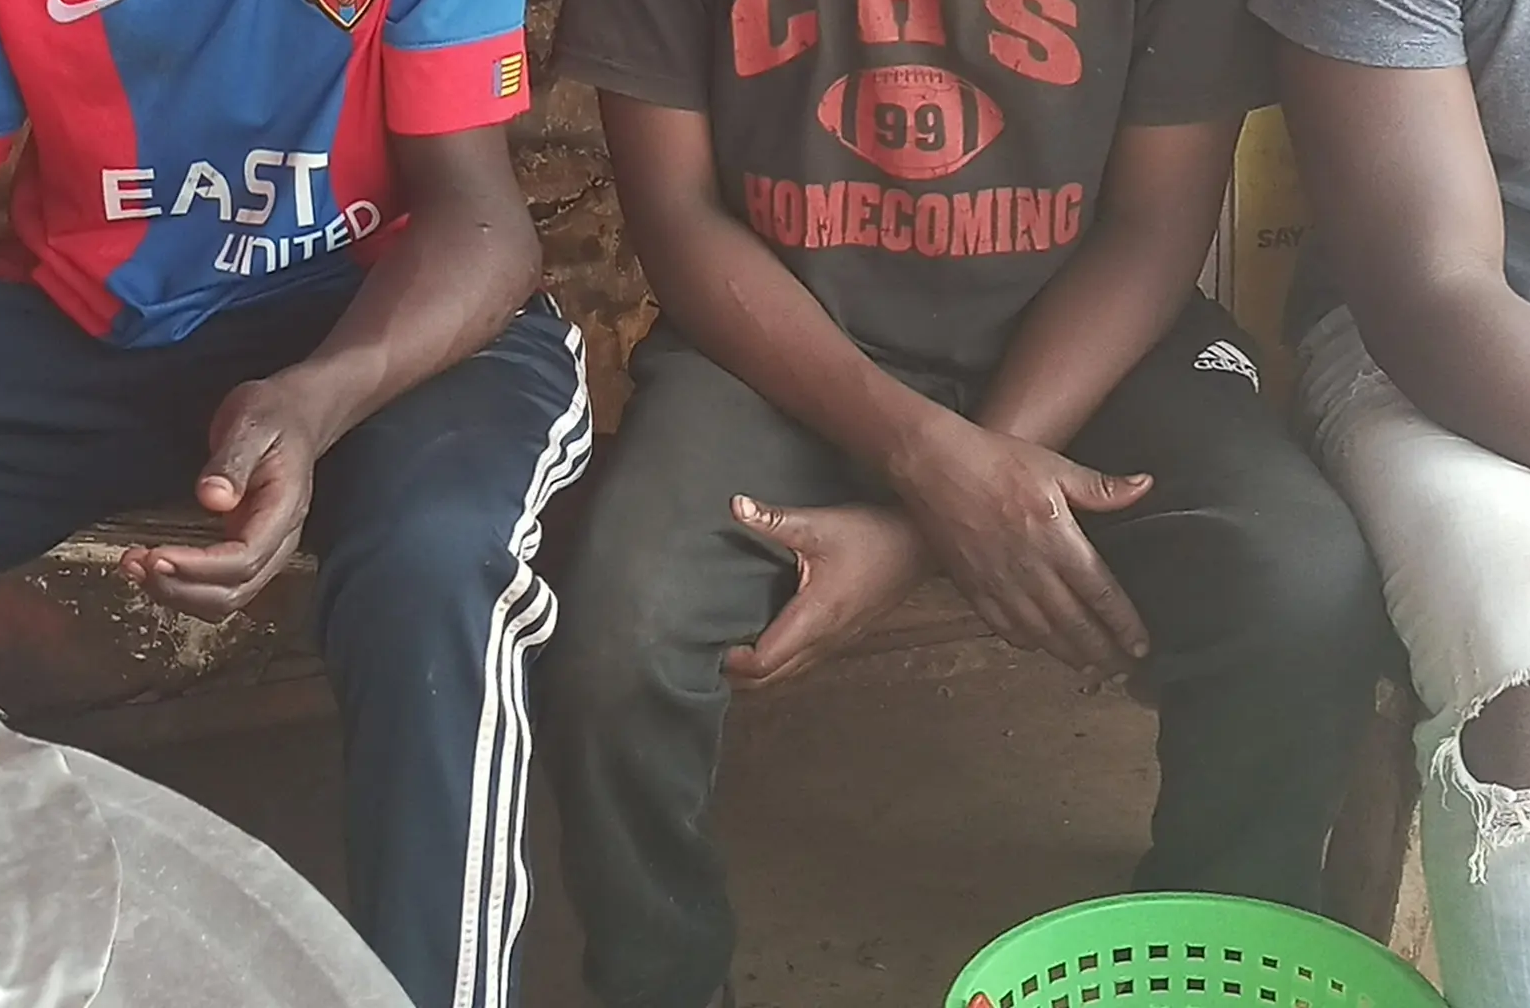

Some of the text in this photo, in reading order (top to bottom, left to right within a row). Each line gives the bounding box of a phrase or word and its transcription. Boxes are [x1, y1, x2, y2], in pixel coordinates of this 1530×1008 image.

[874, 103, 946, 152] 99
[102, 149, 329, 228] EAST
[744, 173, 1084, 258] HOMECOMING
[214, 200, 381, 276] UNITED
